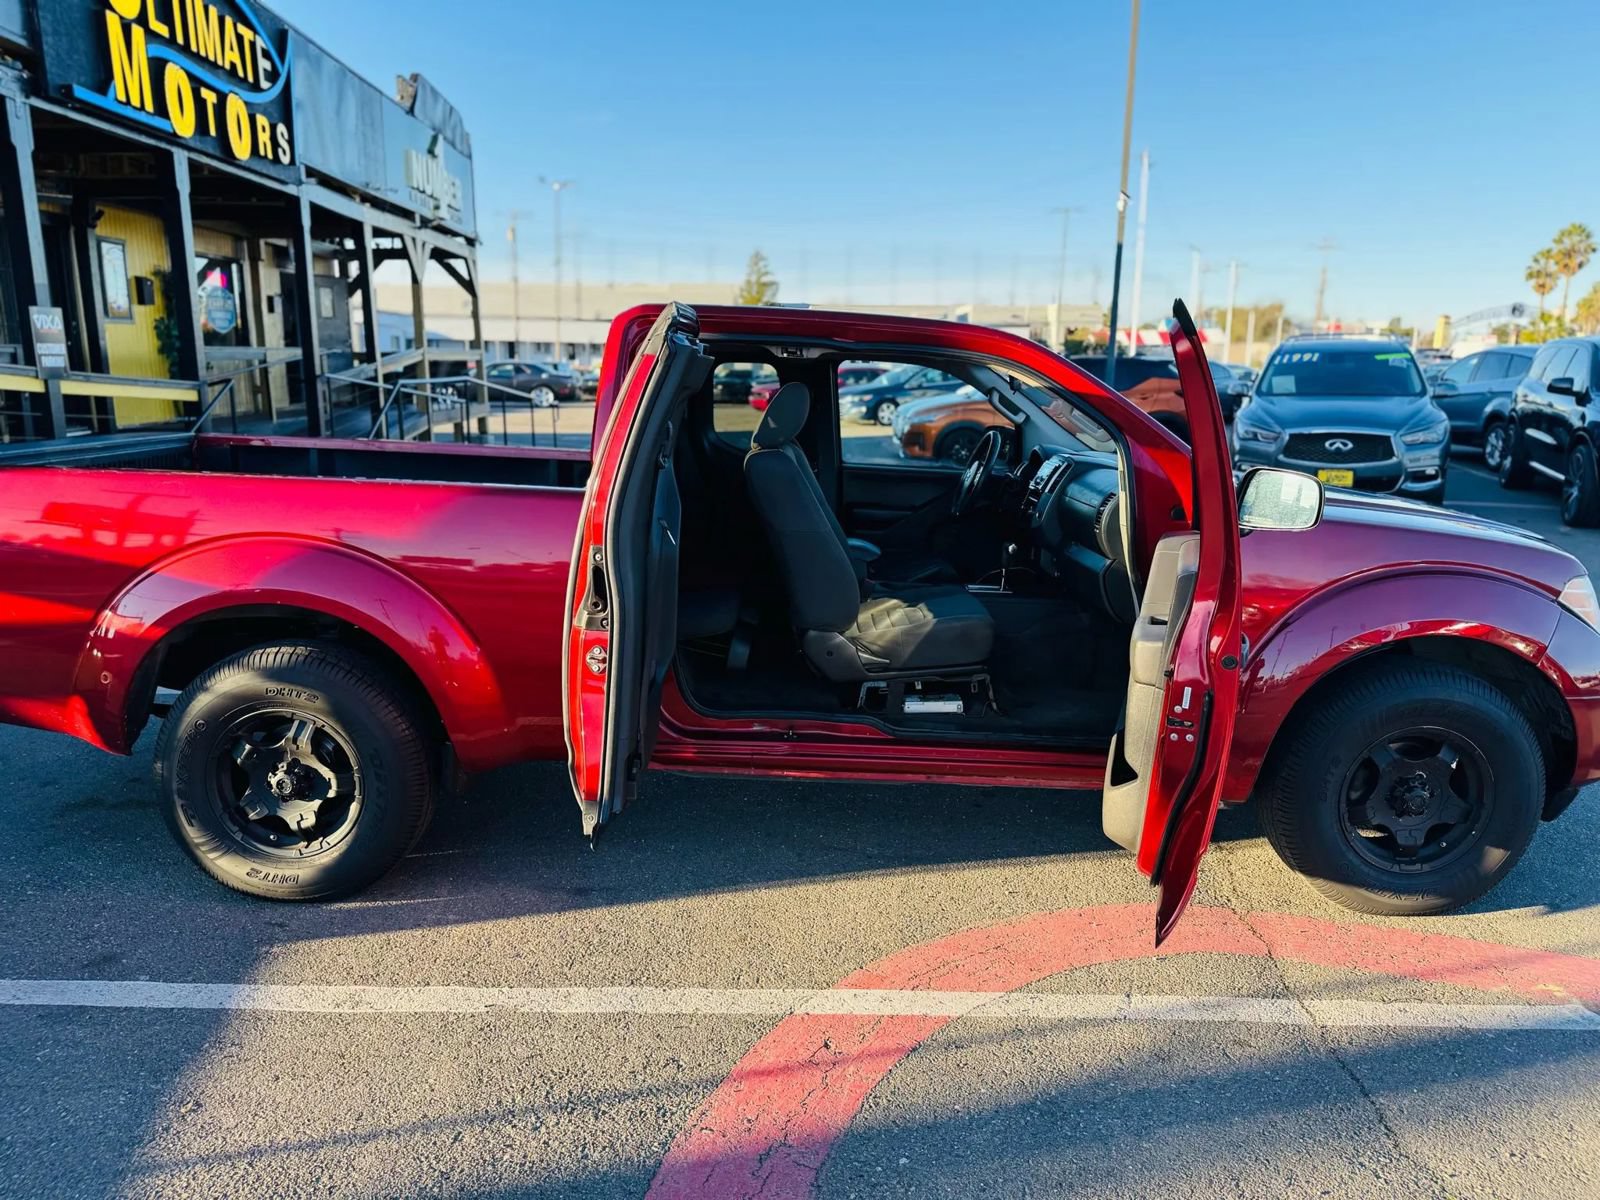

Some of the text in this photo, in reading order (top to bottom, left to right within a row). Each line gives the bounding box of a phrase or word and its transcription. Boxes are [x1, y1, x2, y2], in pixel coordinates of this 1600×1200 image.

[109, 0, 273, 90] LTIMATE
[105, 9, 291, 165] MOTORS
[265, 687, 319, 704] DHT2
[246, 867, 300, 885] DHT2
